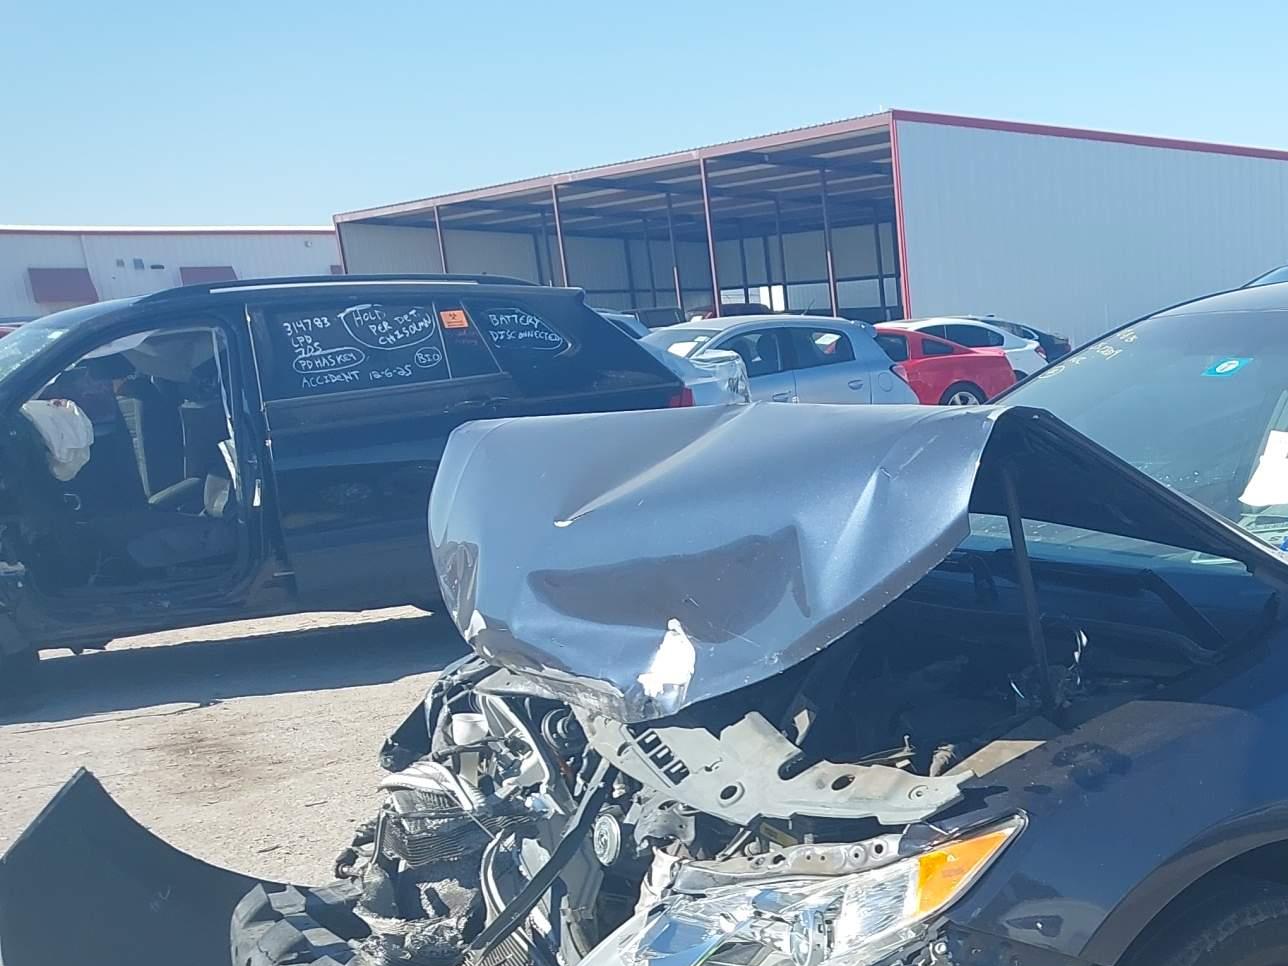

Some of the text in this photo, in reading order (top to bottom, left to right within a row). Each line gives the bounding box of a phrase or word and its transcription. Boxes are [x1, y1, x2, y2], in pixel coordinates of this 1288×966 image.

[283, 316, 331, 336] 314783
[488, 314, 540, 329] BATTERY
[298, 359, 312, 370] PD
[316, 356, 336, 368] HAS
[416, 352, 440, 364] BIO
[302, 365, 412, 388] ACCIDENT 12-6-25
